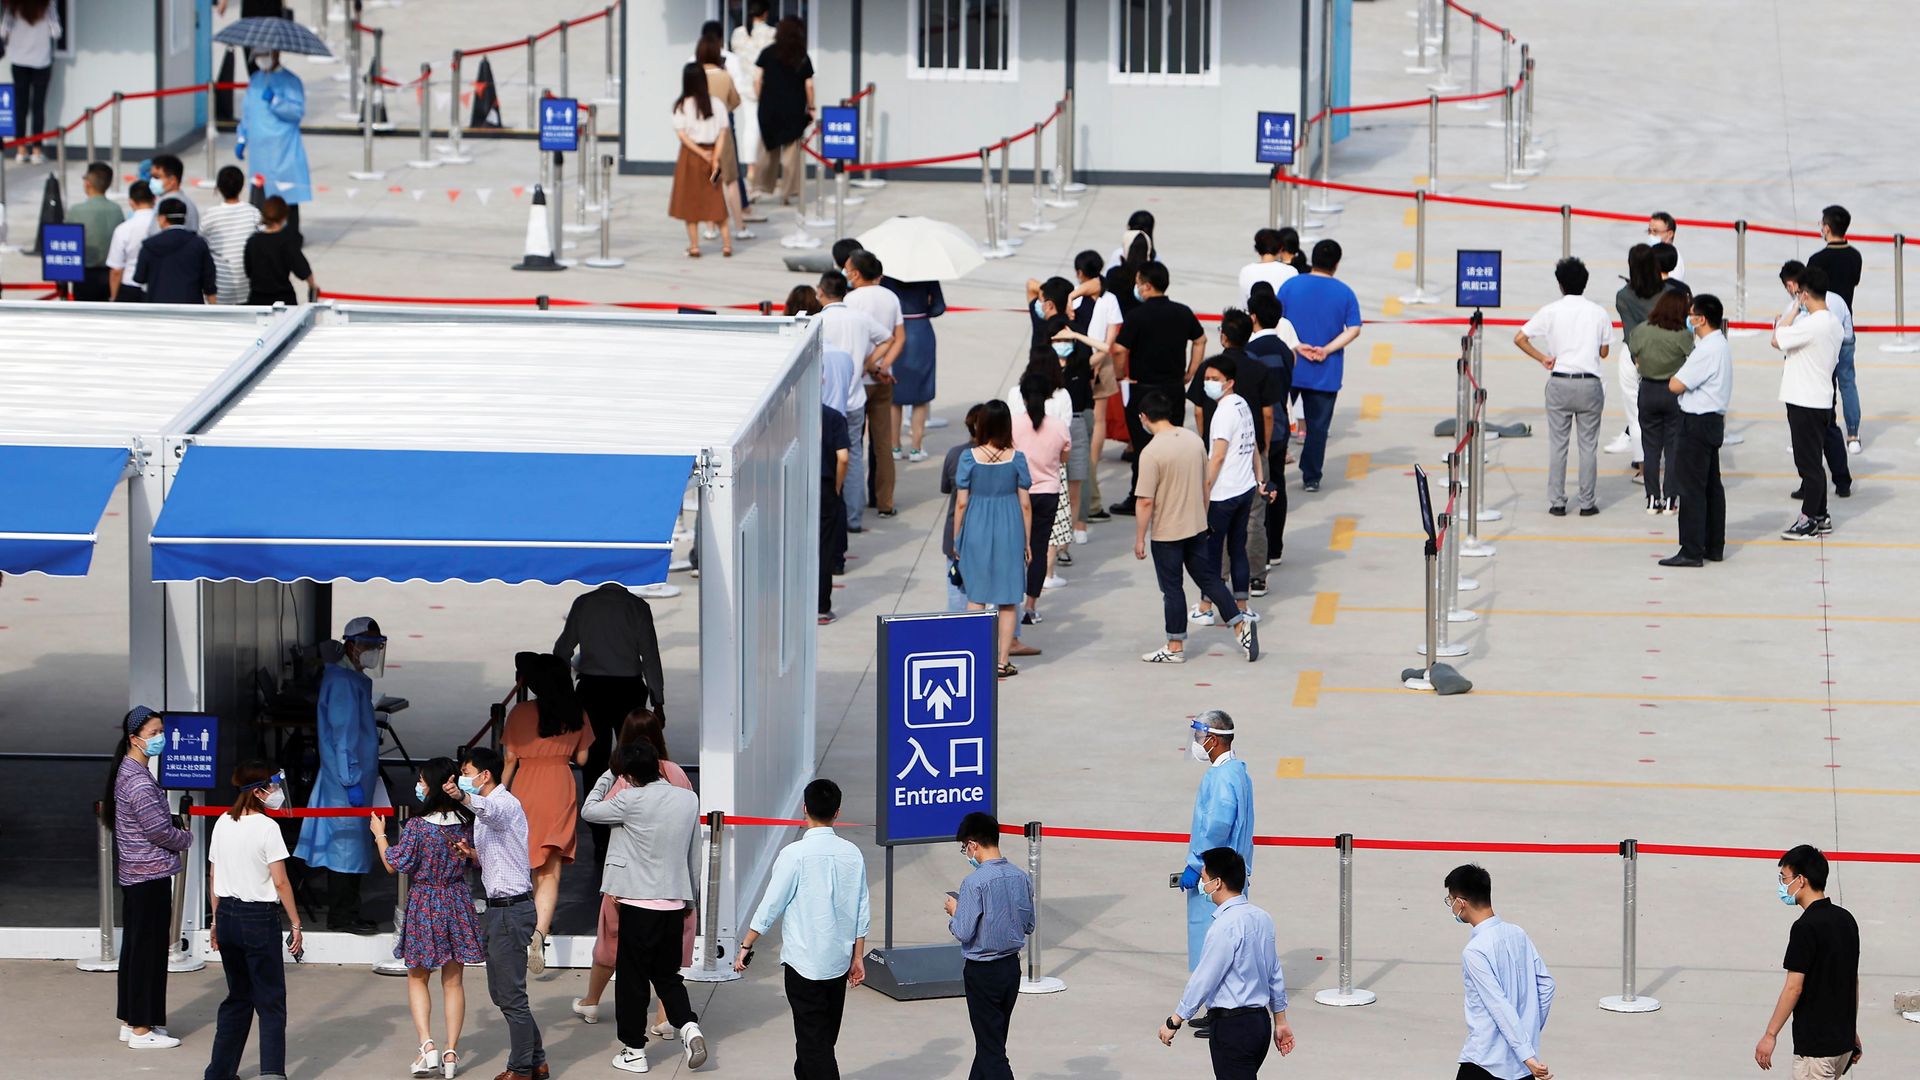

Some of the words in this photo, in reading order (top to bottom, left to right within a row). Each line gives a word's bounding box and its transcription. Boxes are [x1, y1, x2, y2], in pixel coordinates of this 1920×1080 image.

[1466, 266, 1494, 277] 请全程
[1461, 280, 1498, 291] 佩戴口罩
[166, 754, 212, 762] 公共场所请保持
[896, 736, 984, 781] 入口
[166, 763, 212, 771] 1米以上社交距离
[894, 786, 984, 807] Entrance
